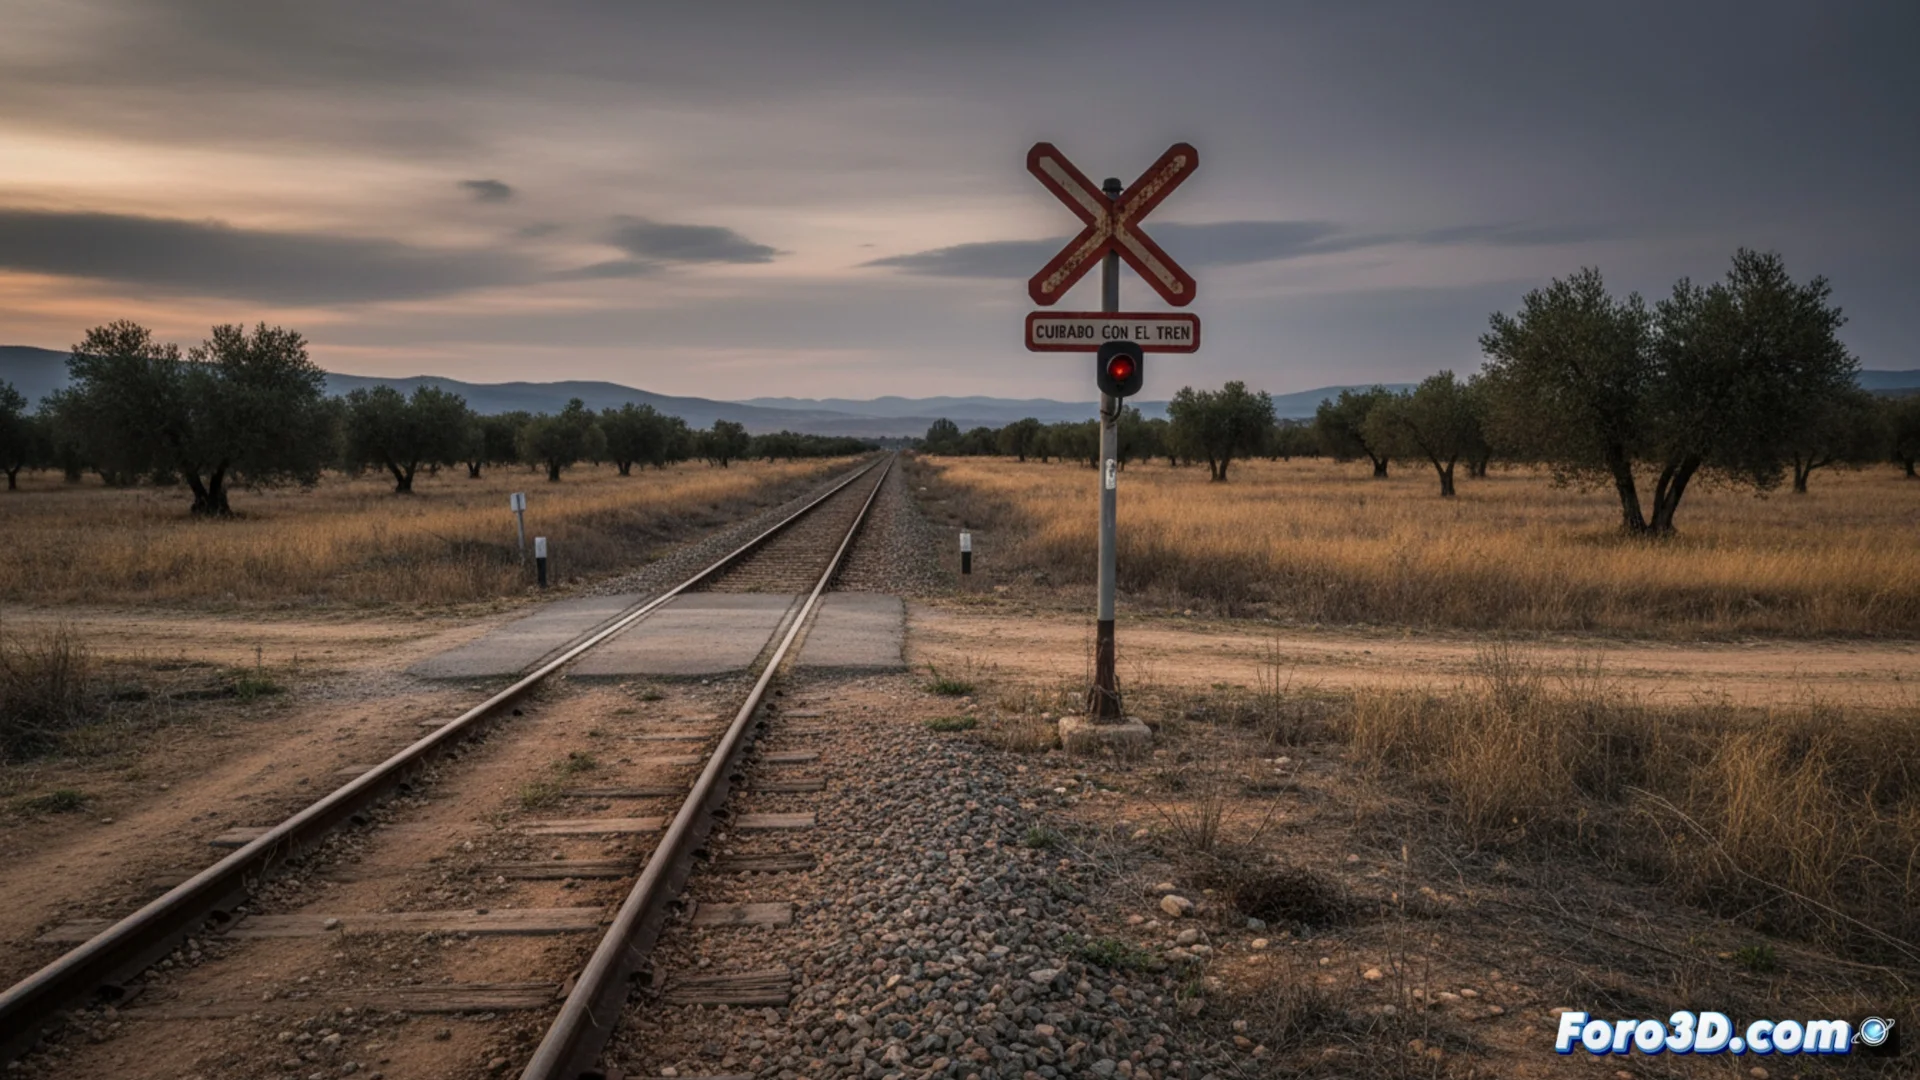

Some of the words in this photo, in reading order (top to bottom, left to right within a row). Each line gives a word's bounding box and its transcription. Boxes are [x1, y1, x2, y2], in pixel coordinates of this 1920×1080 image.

[1102, 325, 1128, 340] CON
[1135, 325, 1150, 340] EL
[1156, 326, 1190, 340] TREN
